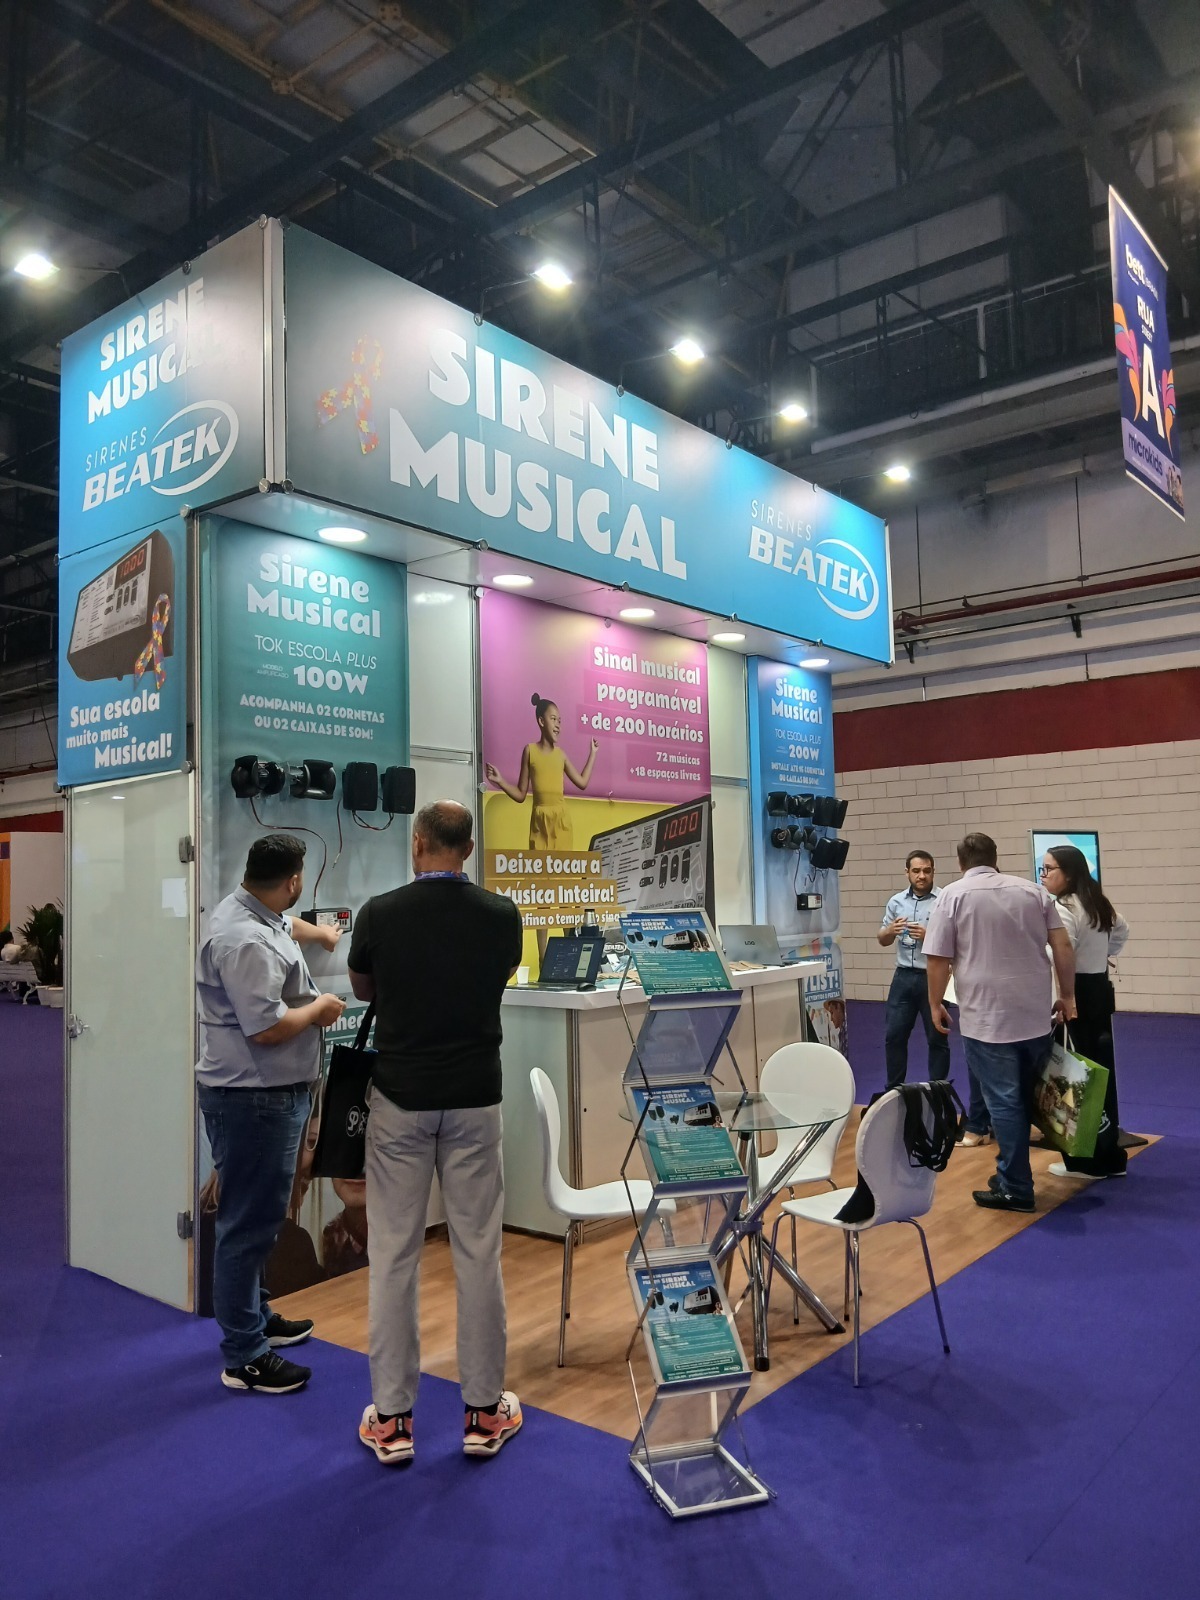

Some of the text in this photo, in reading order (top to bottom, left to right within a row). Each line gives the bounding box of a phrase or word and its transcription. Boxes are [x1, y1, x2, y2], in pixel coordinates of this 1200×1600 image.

[101, 277, 204, 371] SIRENE
[1137, 295, 1155, 333] RUA
[1142, 343, 1165, 439] A
[429, 328, 659, 491] SIRENE
[82, 416, 222, 512] BEATEK
[85, 427, 147, 472] SIRENES
[1128, 433, 1163, 476] microkids
[389, 408, 687, 581] MUSICAL
[751, 500, 812, 541] SIRENES
[259, 552, 370, 603] Sirene
[749, 526, 869, 602] BEATEK
[247, 583, 381, 638] Musical
[254, 635, 378, 670] TOK ESCOLA PLUS
[593, 646, 701, 686] Sinal musical
[293, 664, 369, 696] 100W
[775, 678, 818, 704] Sirene
[70, 689, 160, 728] Sua escola
[239, 693, 385, 724] ACOMPANHA 02 CORNETAS
[597, 683, 702, 714] programável
[771, 697, 823, 725] Musical
[66, 722, 129, 749] muito mais
[254, 714, 374, 740] OU 02 CAIXAS DE SOM!
[580, 712, 704, 743] + de 200 horários
[774, 728, 822, 745] TOK ESCOLA PLUS
[94, 733, 172, 769] Musical!
[656, 751, 700, 766] 72 músicas
[788, 744, 820, 761] 200W
[646, 768, 679, 781] espaços
[680, 769, 701, 781] livres
[495, 852, 601, 874] Deixe tocar a
[558, 883, 615, 904] Inteira!
[547, 915, 554, 925] o
